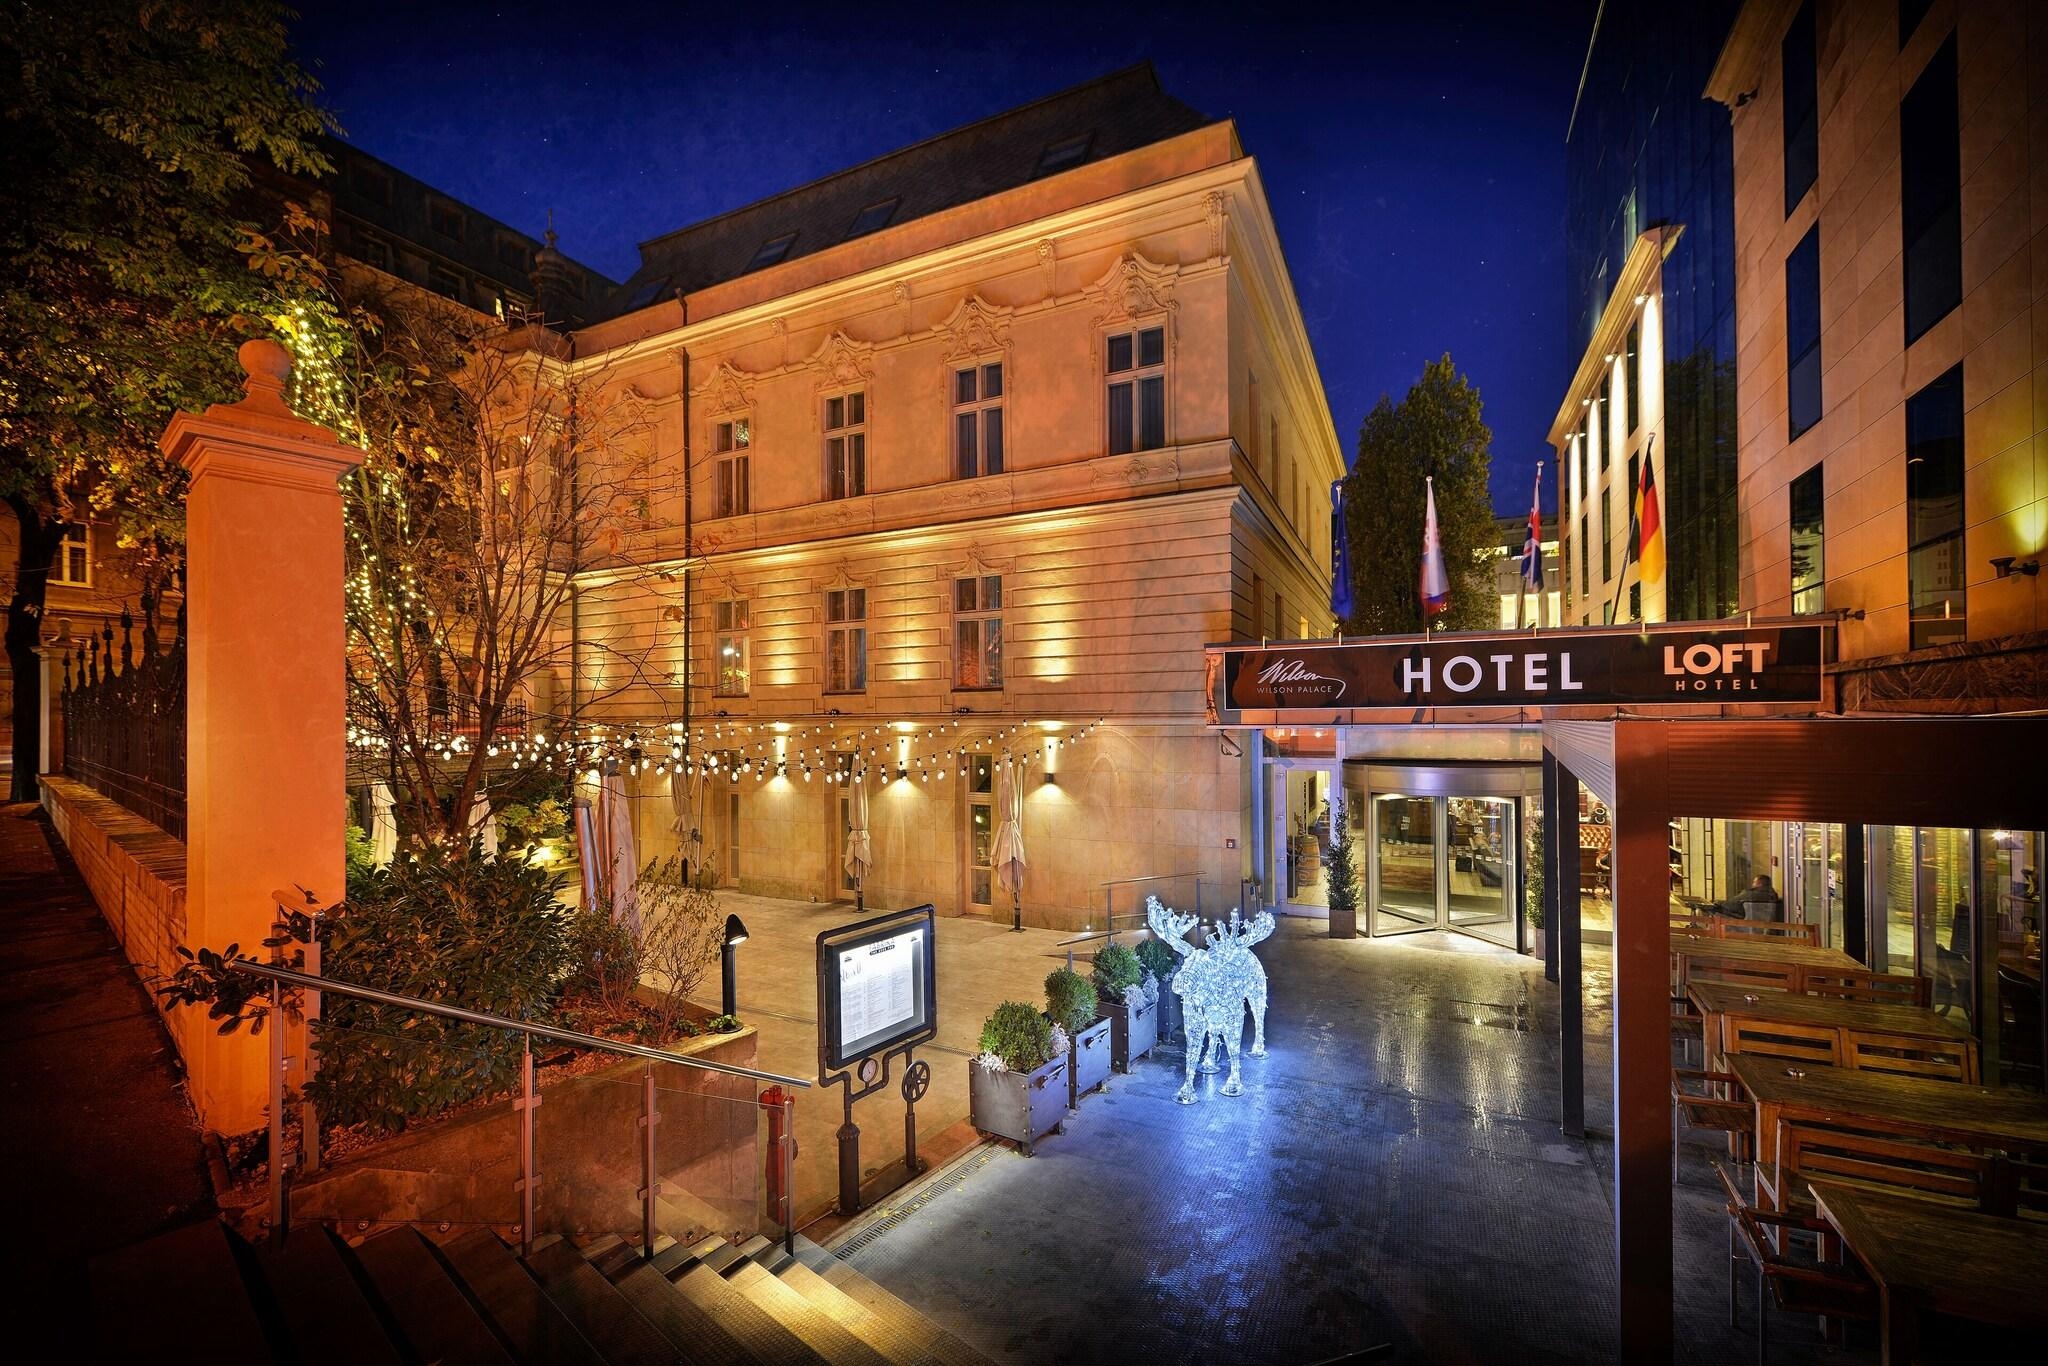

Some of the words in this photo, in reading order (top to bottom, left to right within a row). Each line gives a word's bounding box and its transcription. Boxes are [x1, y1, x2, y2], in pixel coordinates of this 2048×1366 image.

[1403, 652, 1583, 693] HOTEL
[1663, 642, 1771, 675] LOFT
[1256, 686, 1294, 694] WILSON
[1297, 685, 1333, 694] PALACE
[1257, 657, 1347, 700] Wilson
[1675, 679, 1758, 691] HOTEL
